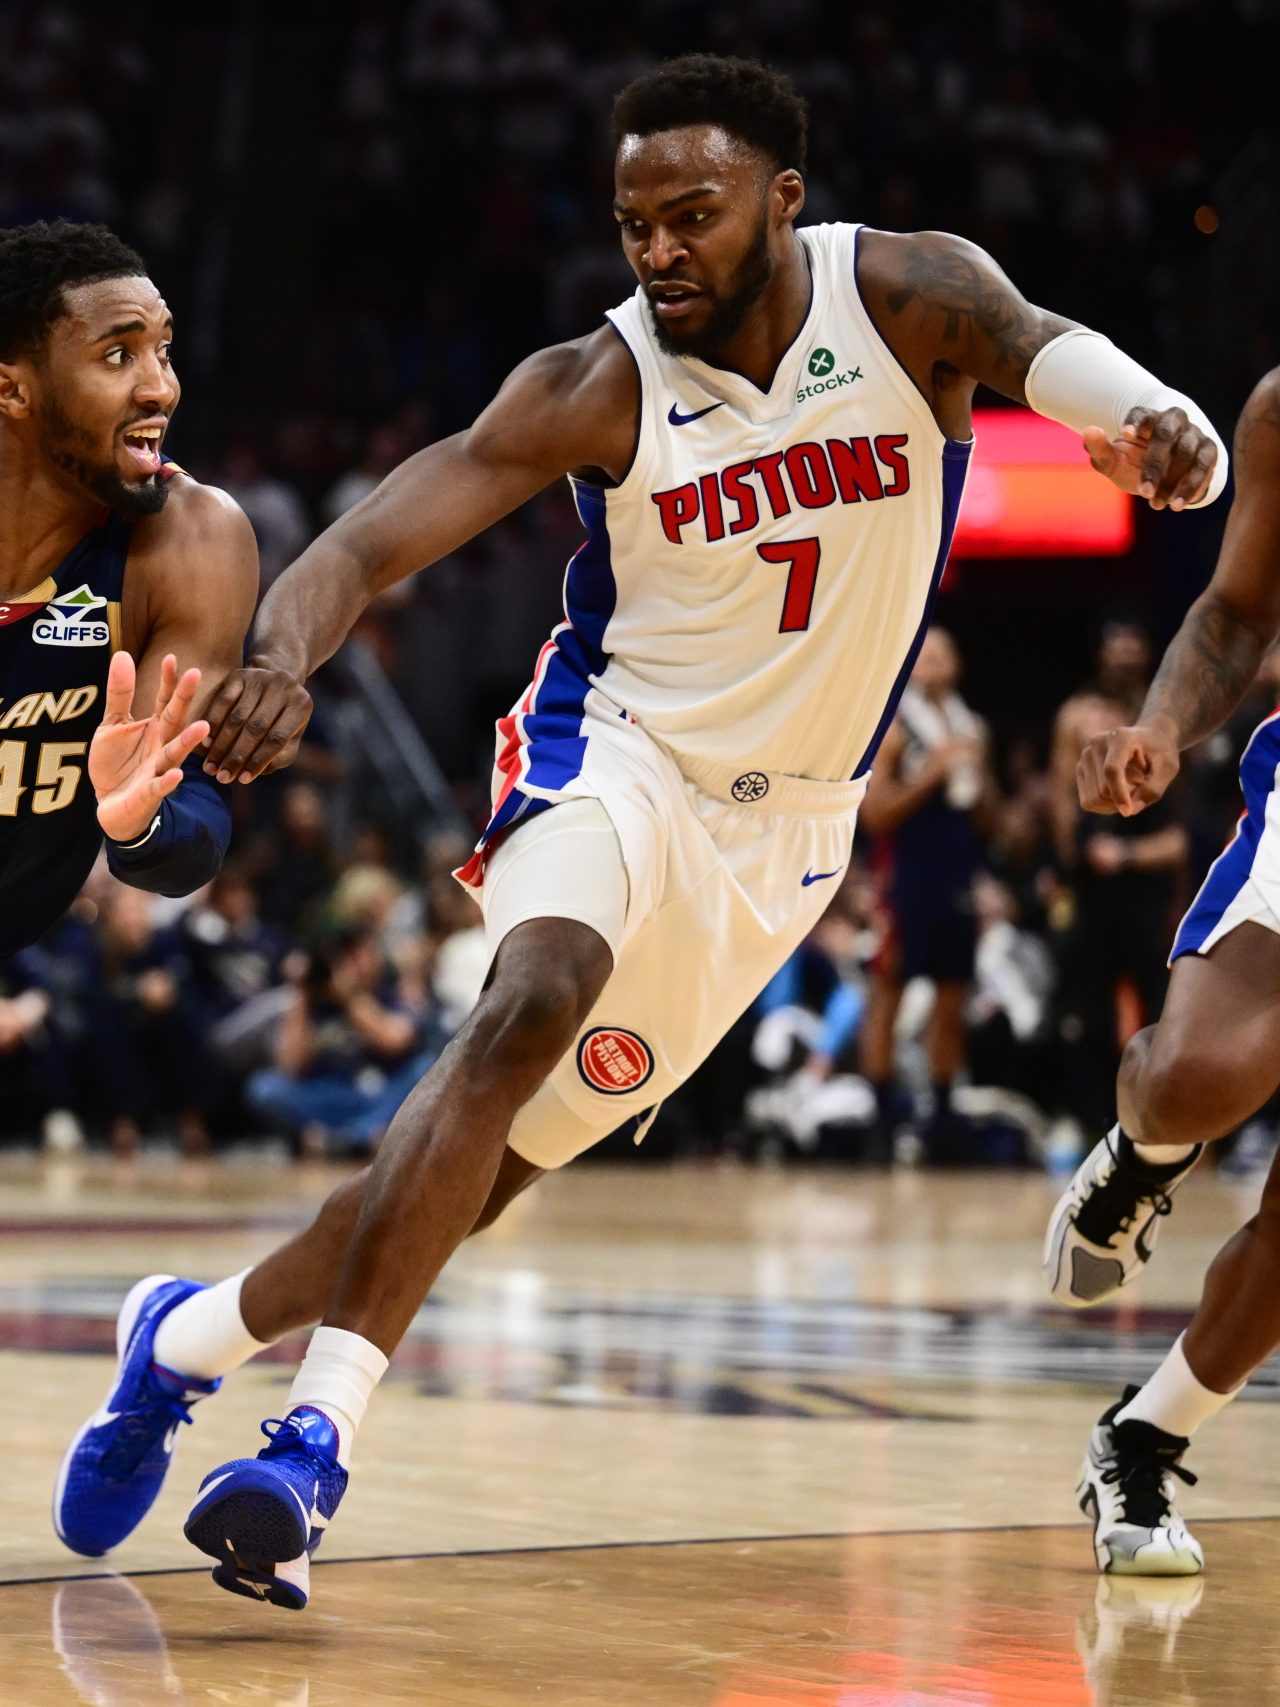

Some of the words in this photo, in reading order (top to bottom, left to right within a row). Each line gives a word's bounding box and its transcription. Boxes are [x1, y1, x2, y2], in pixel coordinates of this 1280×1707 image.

[651, 433, 911, 545] PISTONS
[756, 536, 822, 634] 7
[35, 624, 108, 642] CLIFFS
[592, 1041, 628, 1085] PISTONS
[603, 1036, 639, 1077] DETROIT
